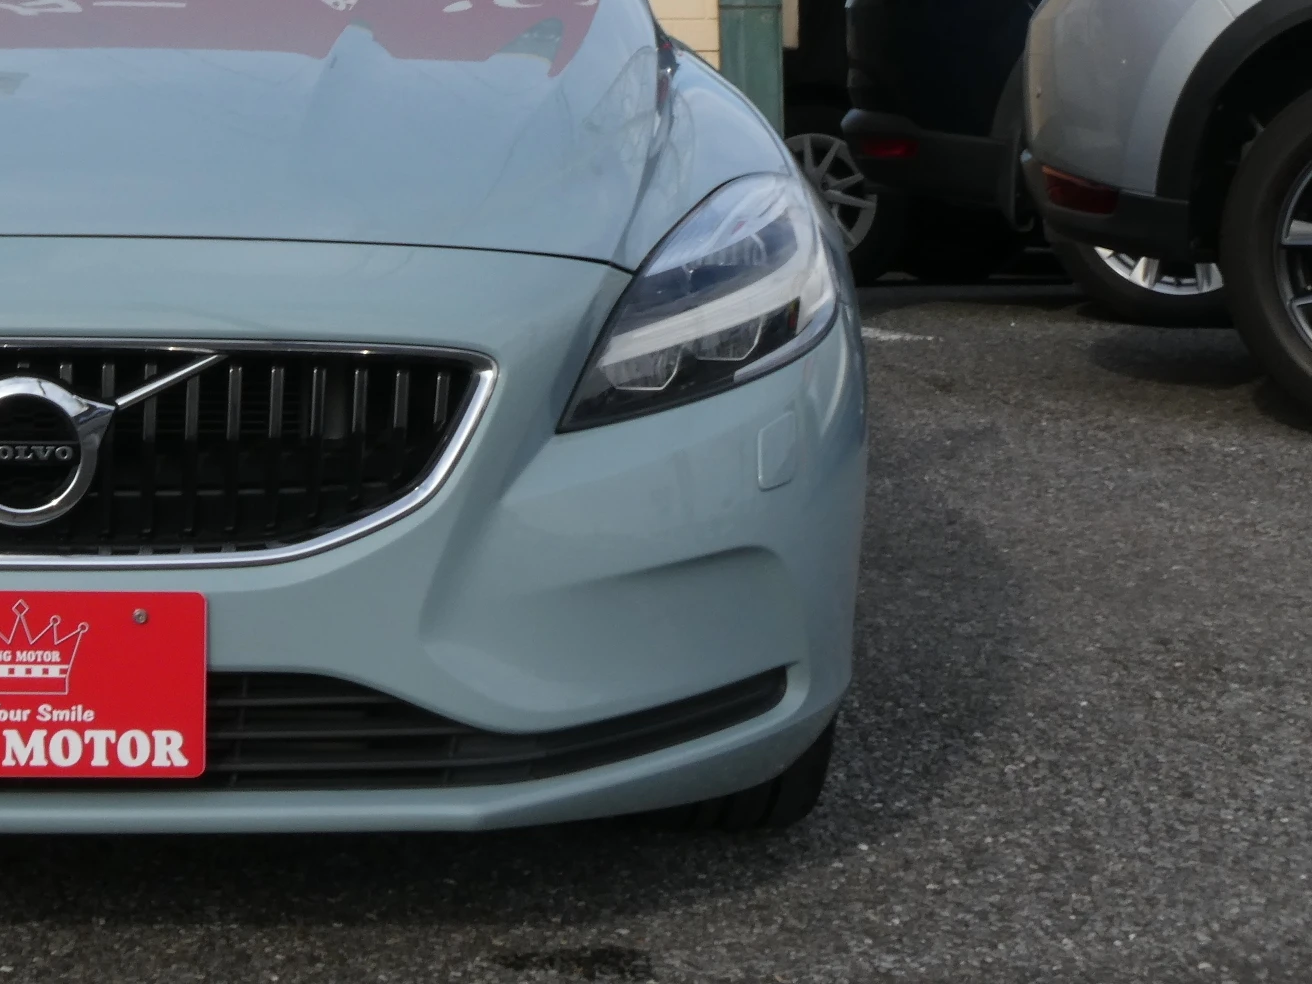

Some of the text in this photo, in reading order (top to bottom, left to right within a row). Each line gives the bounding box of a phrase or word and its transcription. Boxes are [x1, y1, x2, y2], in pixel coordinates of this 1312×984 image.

[15, 650, 61, 663] MOTOR
[36, 703, 95, 723] Smile
[1, 729, 189, 768] MOTOR
